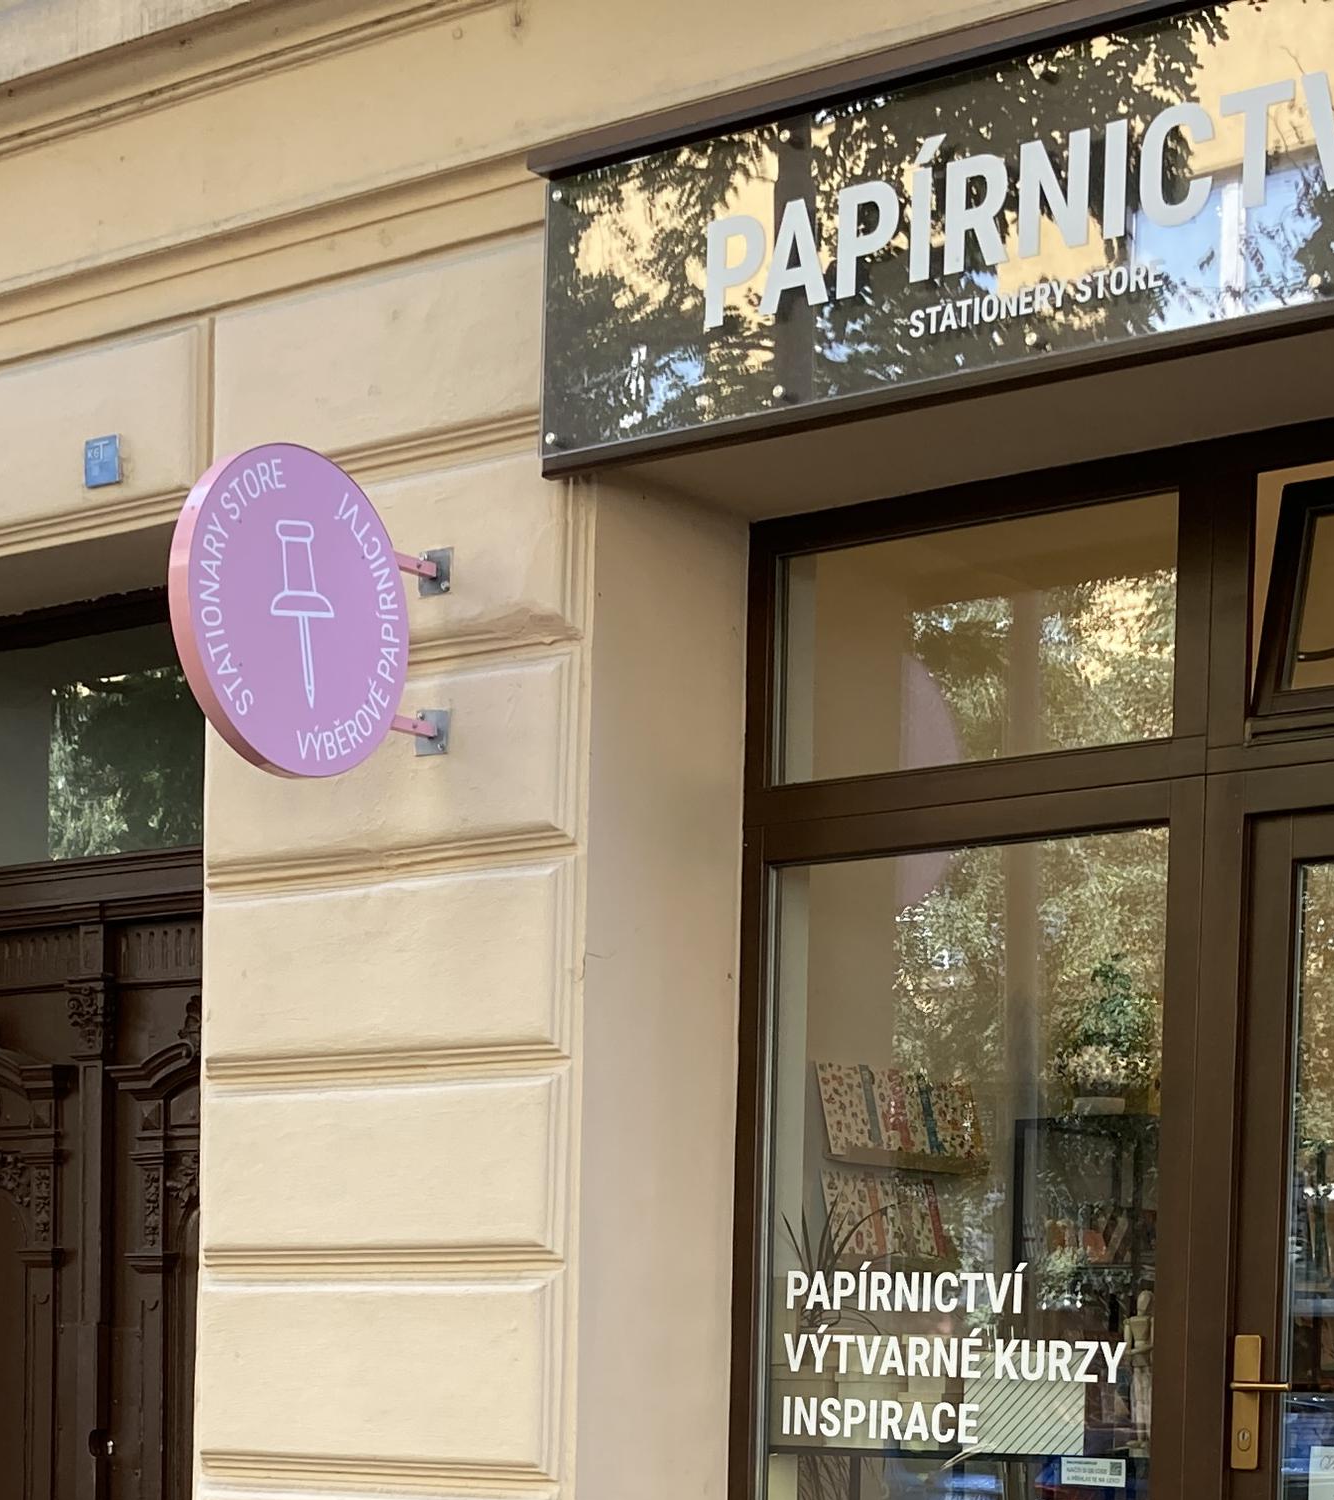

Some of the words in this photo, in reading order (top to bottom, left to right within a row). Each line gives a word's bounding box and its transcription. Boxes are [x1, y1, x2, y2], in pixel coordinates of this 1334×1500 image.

[908, 283, 1068, 339] STATIONERY
[1076, 261, 1165, 307] STORE
[221, 457, 287, 521] STORE
[199, 512, 255, 717] STATIONARY
[333, 492, 400, 685] PAPÍRNICTVÍ
[296, 677, 391, 762] VÝBĚROVÉ
[785, 1260, 1029, 1315] PAPÍRNICTVÍ
[784, 1323, 984, 1380] VÝTVARNÉ
[994, 1338, 1127, 1384] KURZY
[781, 1395, 980, 1444] INSPIRACE
